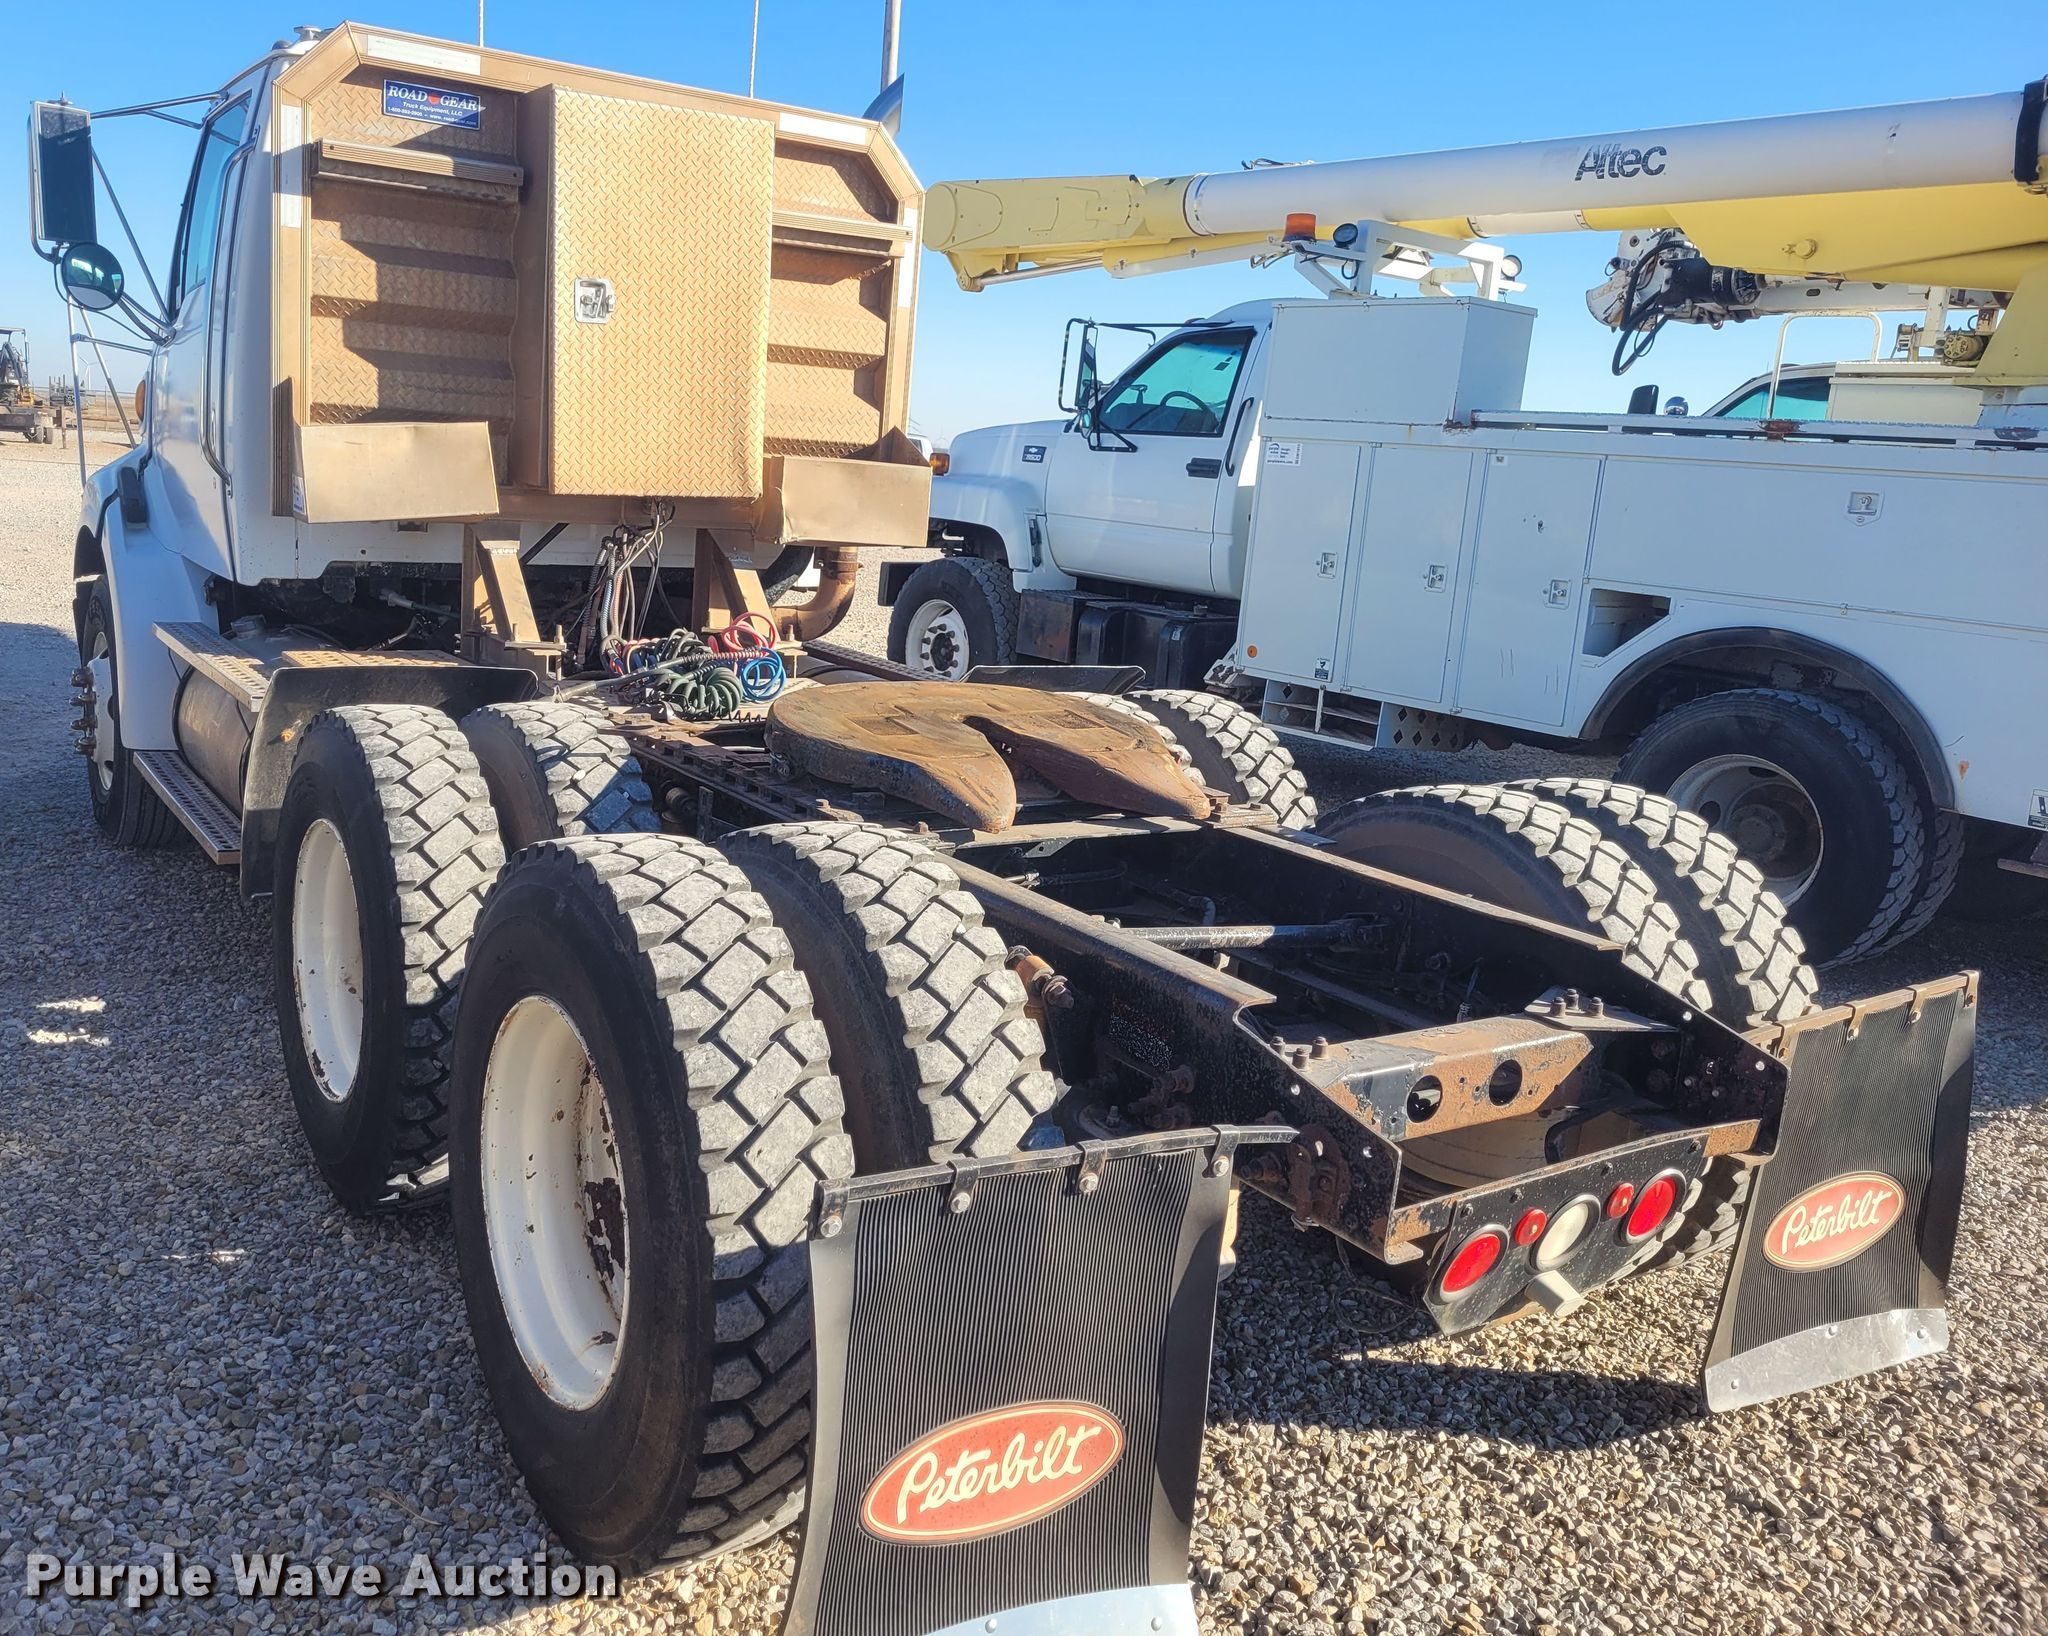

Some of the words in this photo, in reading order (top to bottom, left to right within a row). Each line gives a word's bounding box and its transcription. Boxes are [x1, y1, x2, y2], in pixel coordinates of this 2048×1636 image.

[388, 85, 428, 102] ROAD
[440, 95, 478, 111] GEAR
[403, 101, 418, 110] Truck
[1575, 144, 1667, 181] Altec
[1780, 1188, 1893, 1257] Peterbilt
[896, 1425, 1102, 1525] Peterbilt
